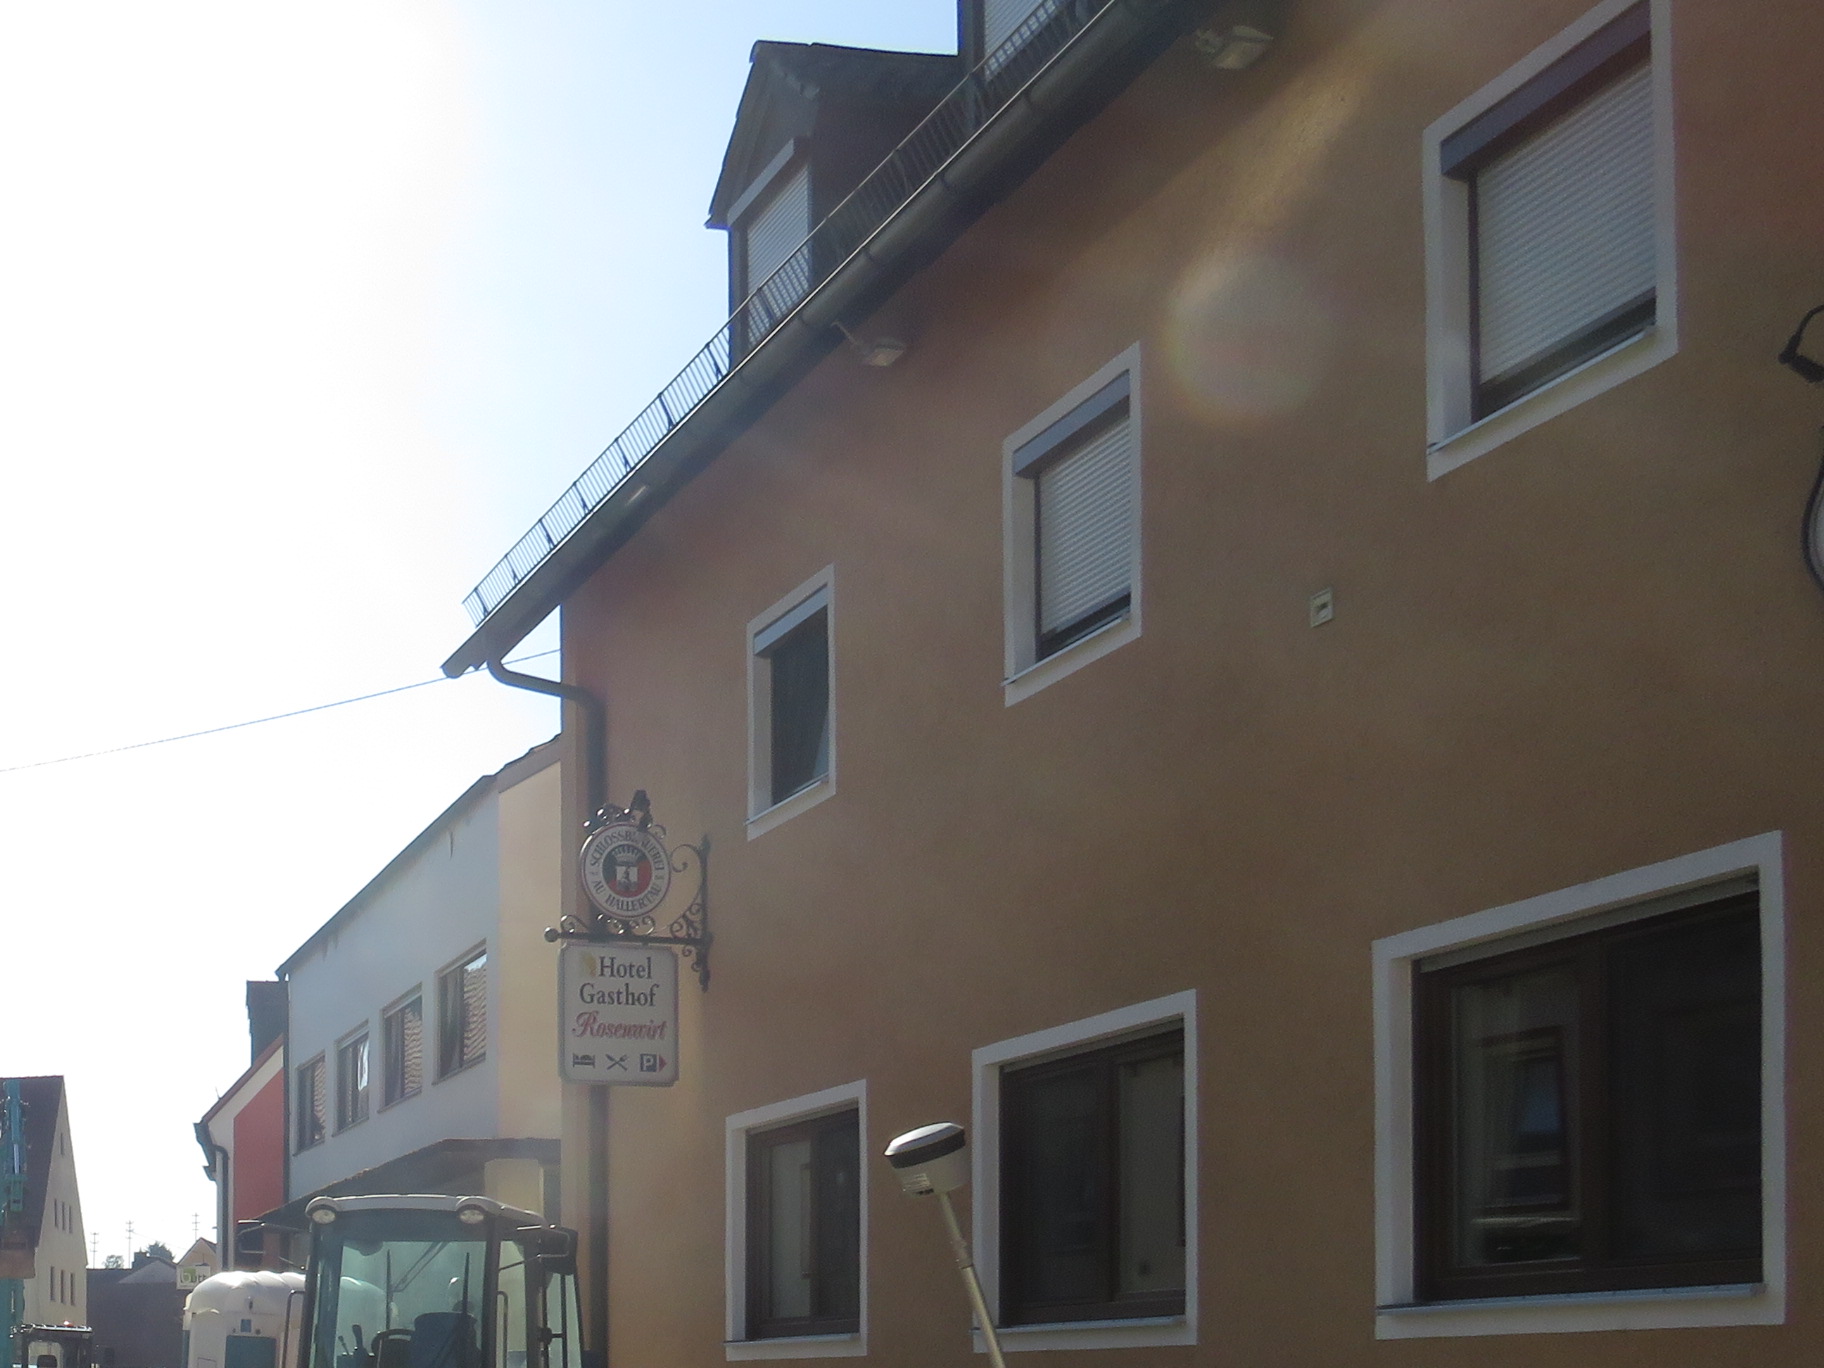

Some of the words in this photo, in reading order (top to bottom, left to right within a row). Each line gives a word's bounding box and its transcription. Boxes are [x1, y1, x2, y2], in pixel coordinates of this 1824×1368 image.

[590, 828, 665, 871] SCHLOSSBUEREI
[592, 879, 606, 895] AU
[598, 956, 653, 979] Hotel
[579, 982, 660, 1006] Gasthof
